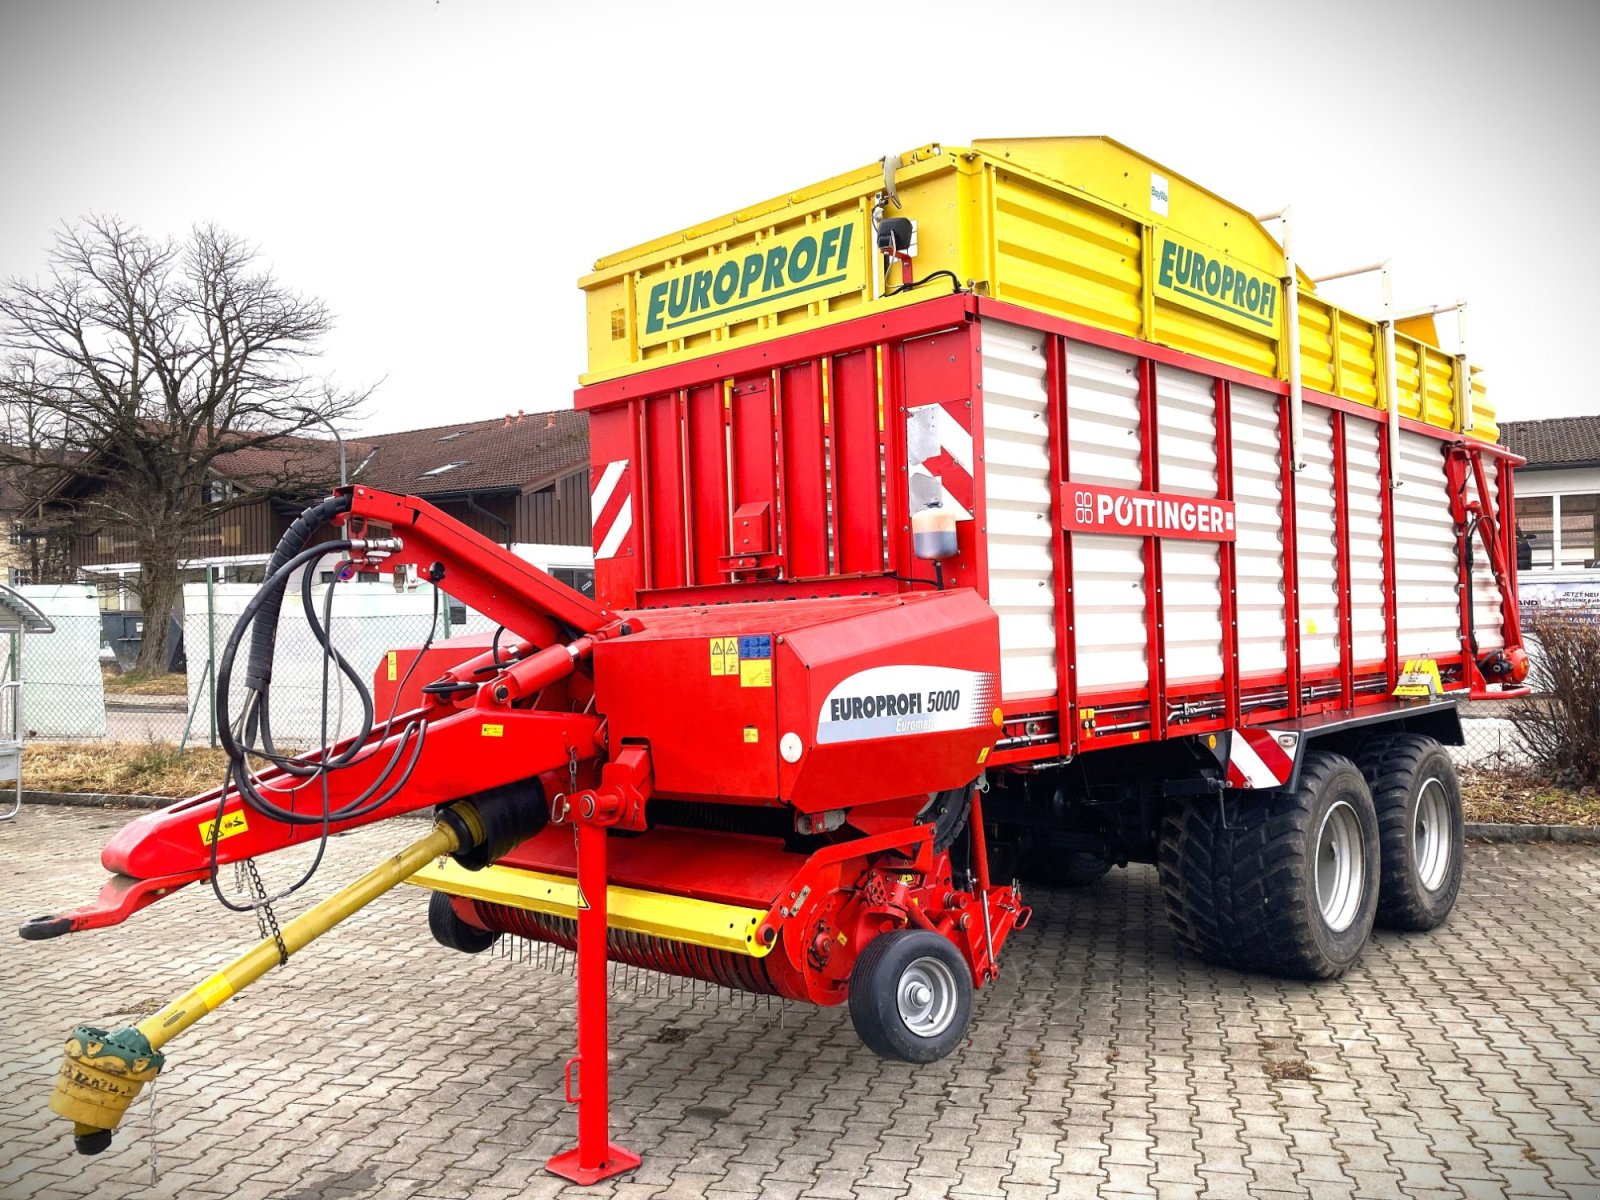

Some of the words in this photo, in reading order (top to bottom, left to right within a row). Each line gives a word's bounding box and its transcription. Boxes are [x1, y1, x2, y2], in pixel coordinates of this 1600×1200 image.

[645, 223, 855, 334] EUROPROFI
[1158, 239, 1277, 319] EUROPROFI
[1096, 494, 1224, 533] PÖTTINGER
[830, 693, 922, 721] EUROPROFI
[927, 689, 960, 713] 5000
